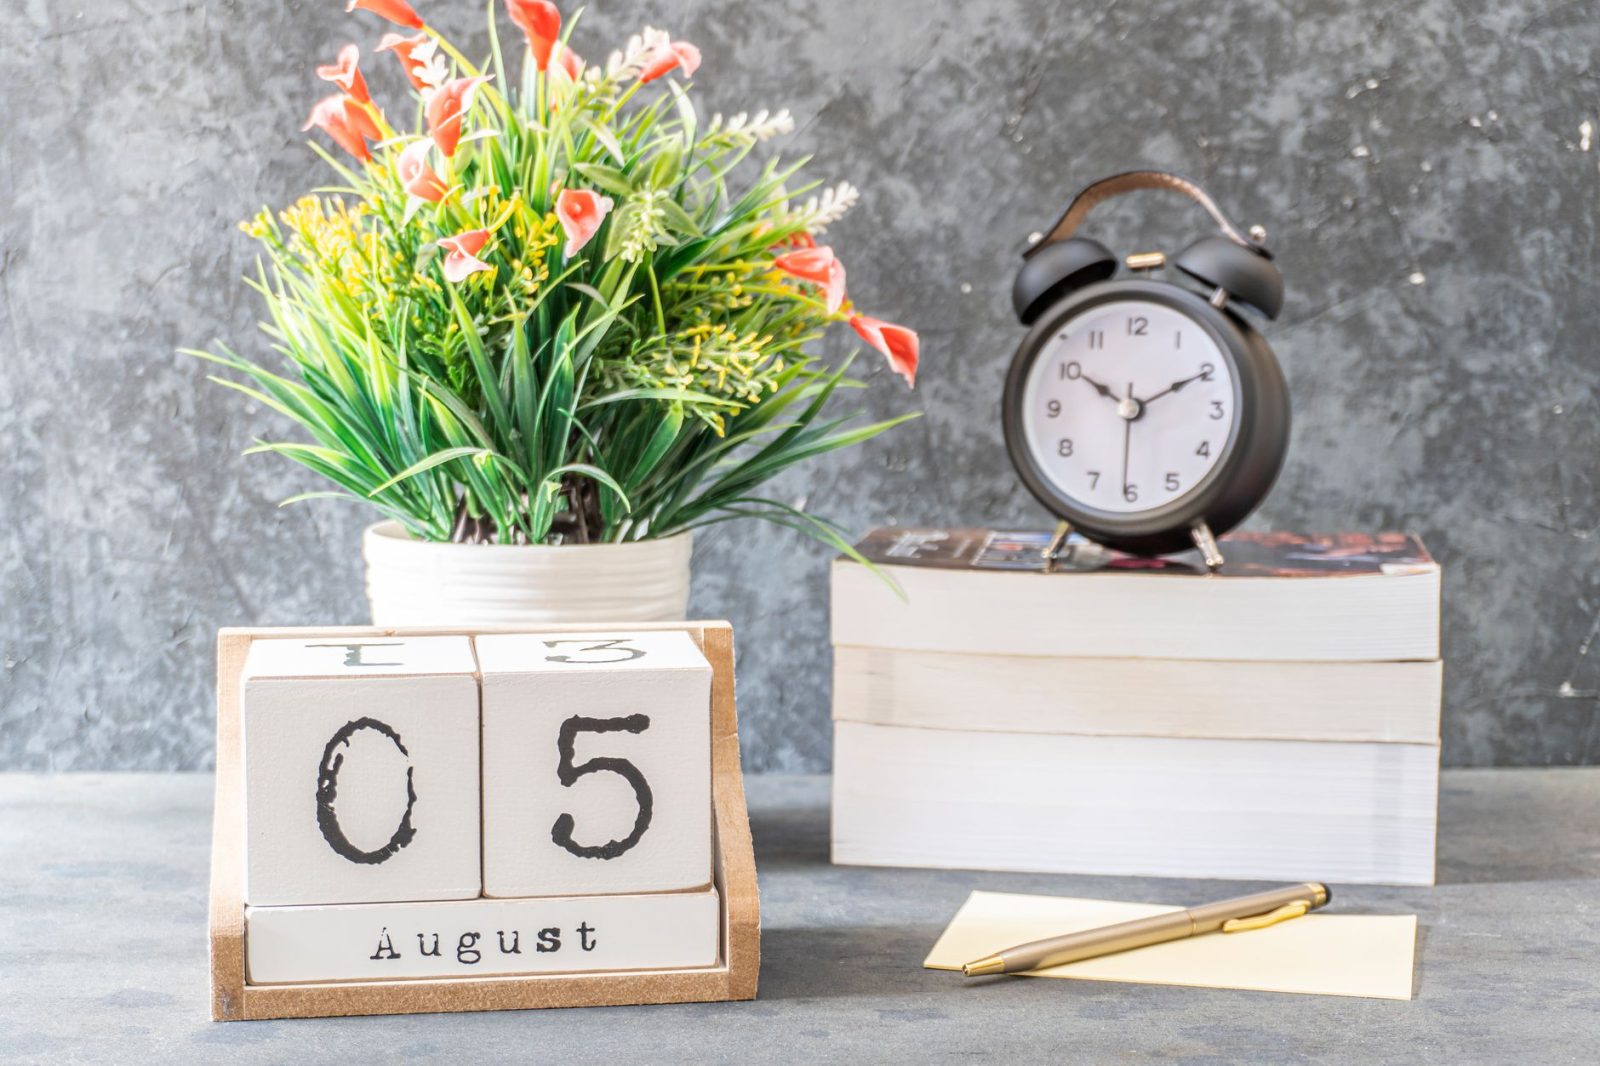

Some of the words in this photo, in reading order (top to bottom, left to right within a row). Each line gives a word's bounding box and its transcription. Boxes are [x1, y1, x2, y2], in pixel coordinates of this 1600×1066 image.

[1127, 317, 1149, 336] 12
[1089, 331, 1104, 349] 11
[1059, 361, 1082, 381] 10
[1200, 363, 1215, 382] 2
[1046, 400, 1062, 418] 9
[1209, 401, 1224, 420] 3
[1058, 439, 1073, 458] 8
[1195, 441, 1211, 459] 4
[1086, 471, 1101, 490] 7
[1165, 473, 1180, 491] 5
[1124, 484, 1138, 503] 6
[551, 713, 653, 860] 5
[370, 920, 598, 965] August
